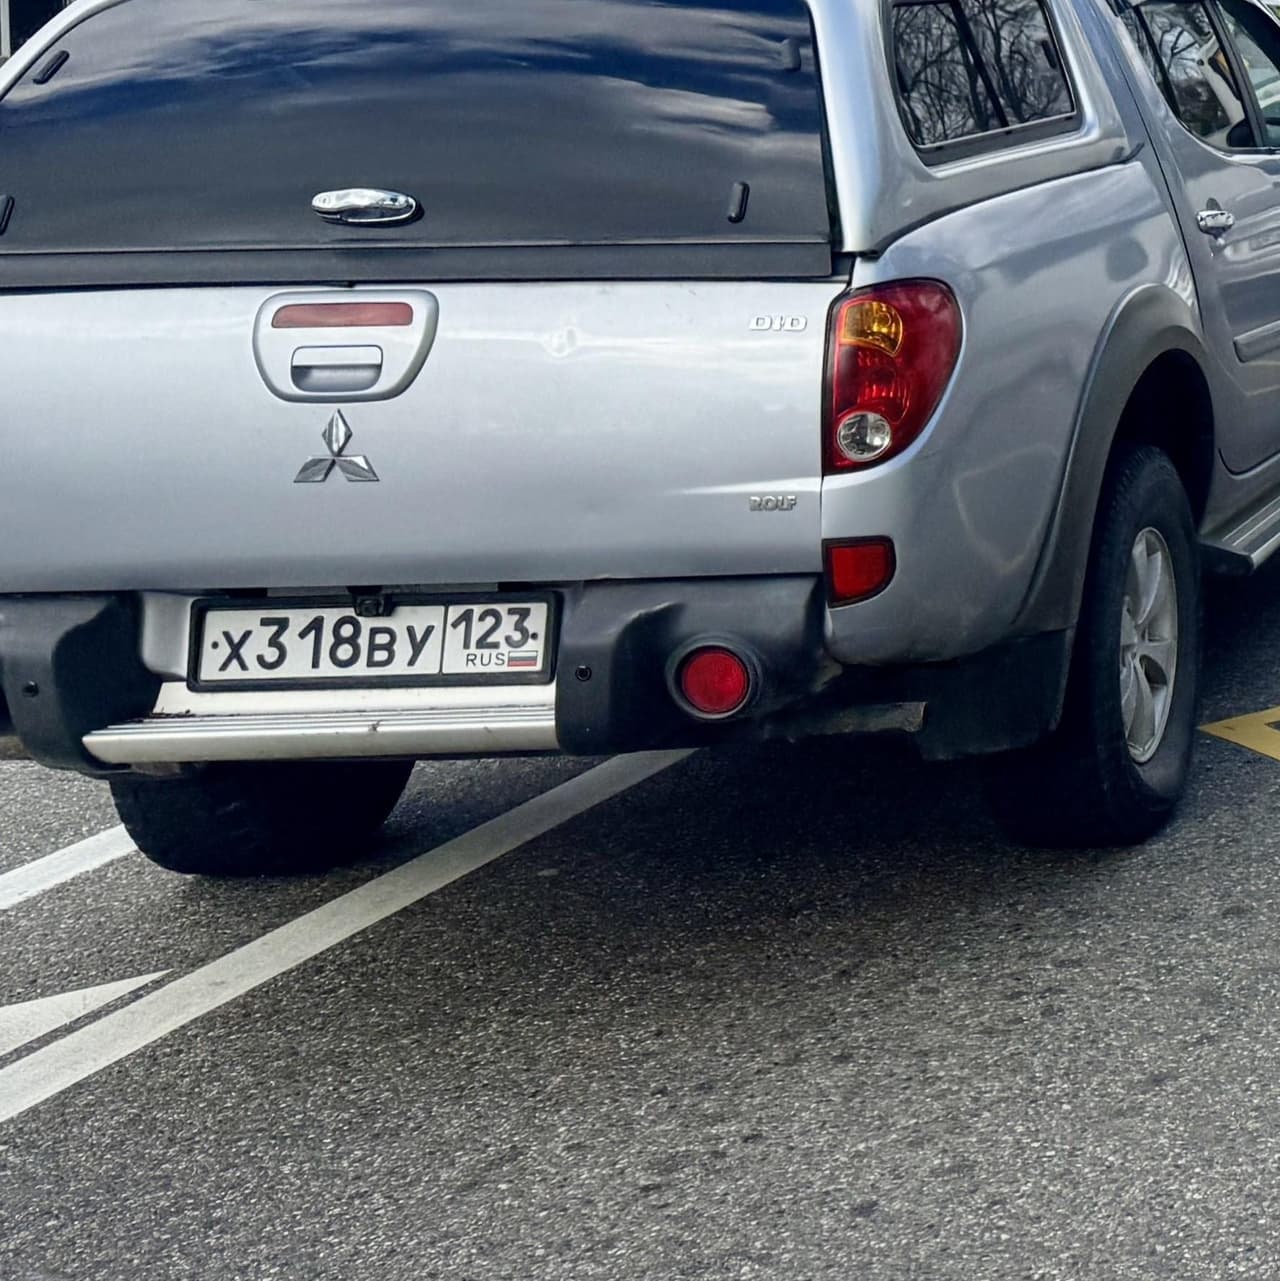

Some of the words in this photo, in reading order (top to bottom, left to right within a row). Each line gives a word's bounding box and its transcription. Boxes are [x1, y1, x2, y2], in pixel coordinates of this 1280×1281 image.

[750, 495, 797, 511] ROLF
[217, 614, 435, 672] Х318ВУ
[451, 606, 531, 650] 123
[465, 651, 506, 668] RUS
